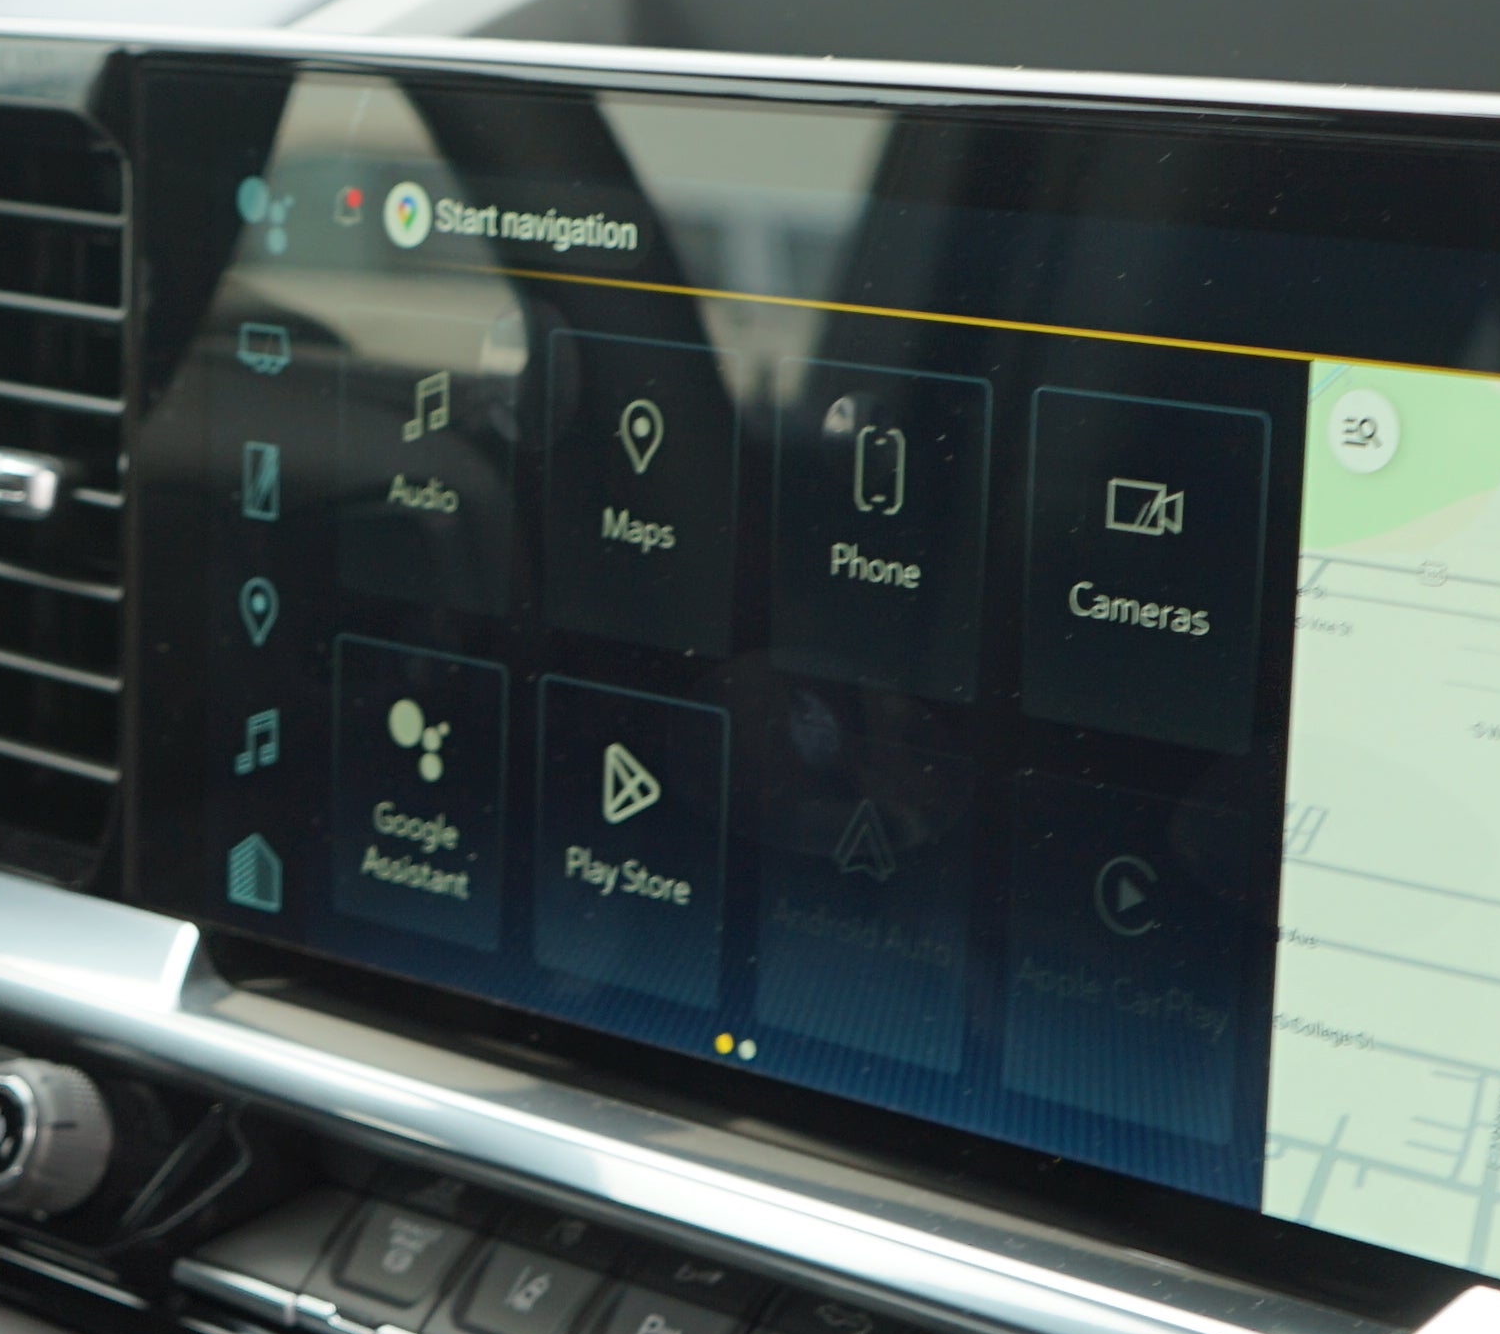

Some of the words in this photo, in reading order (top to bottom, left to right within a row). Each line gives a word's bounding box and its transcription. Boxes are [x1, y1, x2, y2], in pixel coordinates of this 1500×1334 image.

[434, 197, 498, 237] Start
[501, 208, 638, 251] navigation
[387, 473, 460, 514] Audio
[601, 506, 677, 554] Maps
[829, 541, 922, 589] Phone
[1067, 581, 1211, 636] Cameras
[373, 801, 459, 853] Google
[360, 845, 470, 901] Assistant
[565, 845, 618, 896] Play
[620, 858, 692, 905] Store
